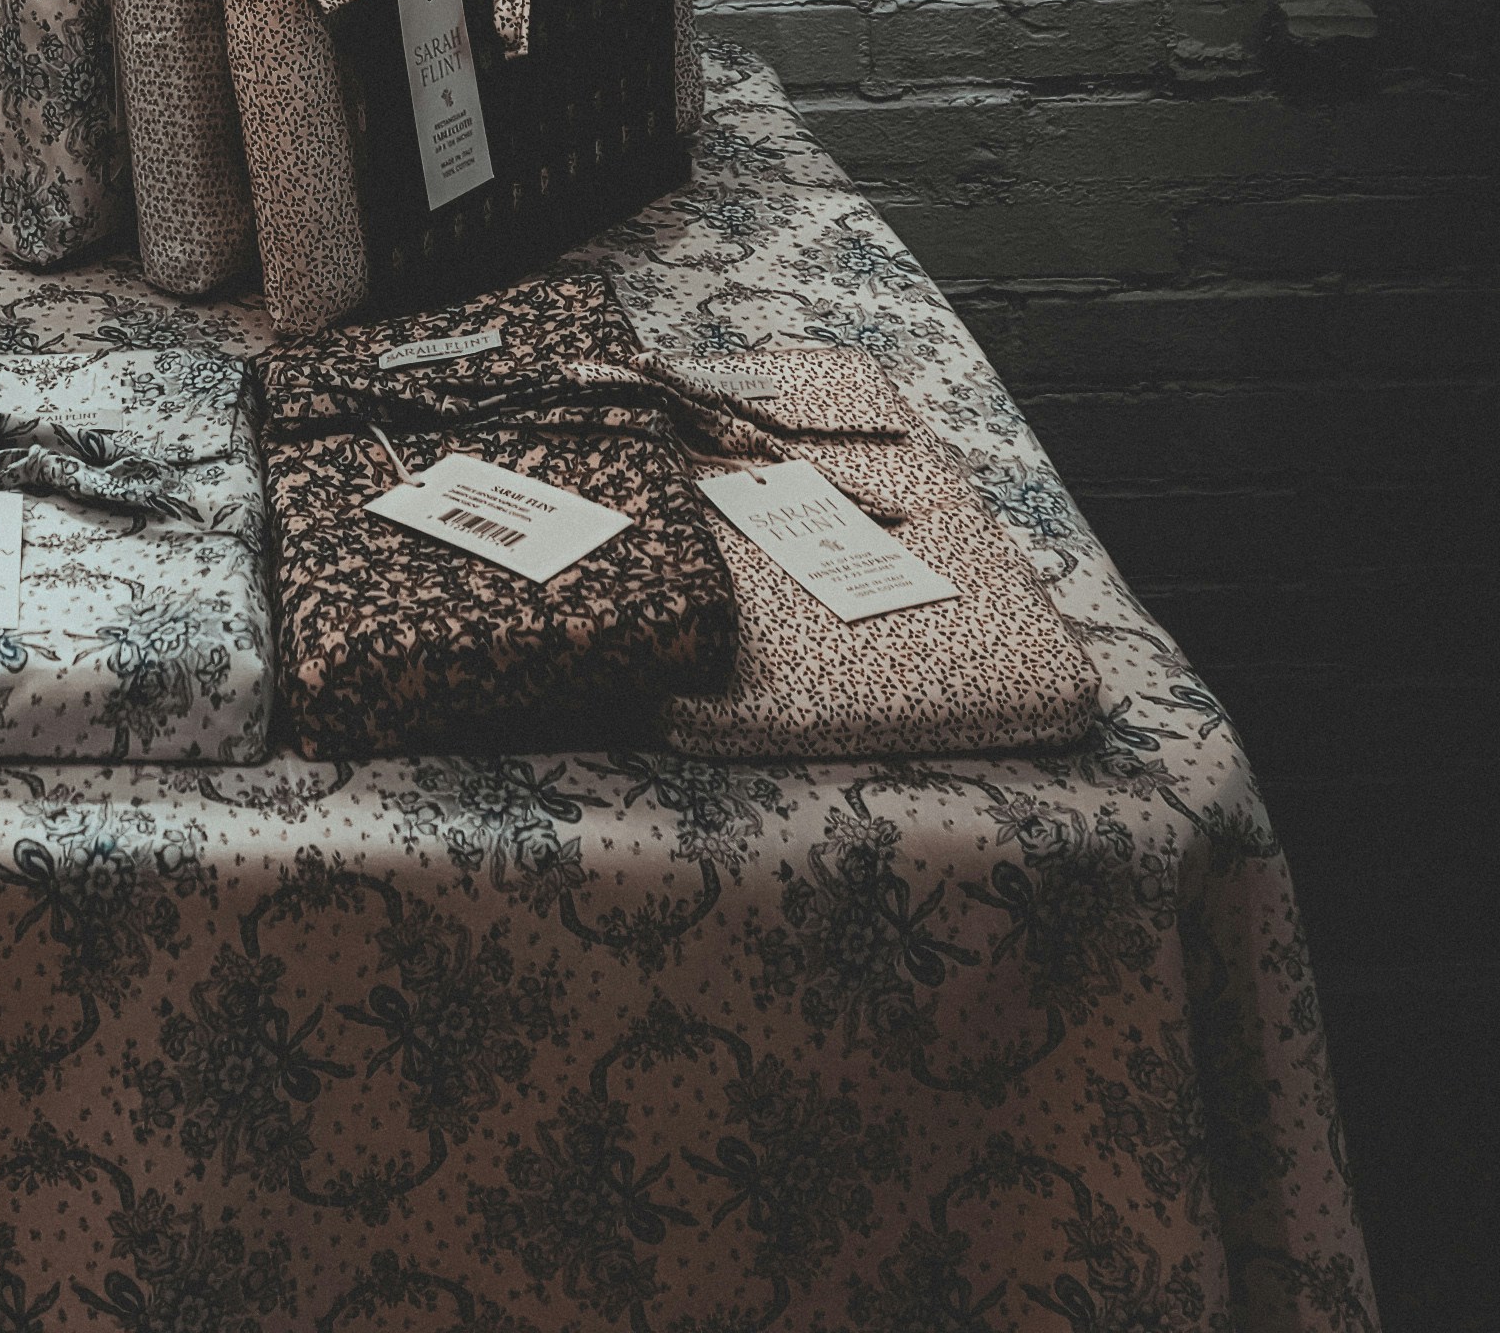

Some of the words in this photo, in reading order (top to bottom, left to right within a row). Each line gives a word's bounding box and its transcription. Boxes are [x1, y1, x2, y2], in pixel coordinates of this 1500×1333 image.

[414, 26, 461, 66] SARAH
[421, 50, 462, 87] FLINT
[432, 117, 473, 144] TABLECLOTH
[444, 336, 490, 351] FLINT
[720, 379, 765, 391] FLINT
[490, 485, 526, 502] SARAH
[525, 498, 558, 514] FLINT
[748, 496, 839, 528] SARAH
[769, 513, 847, 541] FLINT
[808, 564, 852, 580] DINNER
[852, 553, 903, 568] NAPKINS
